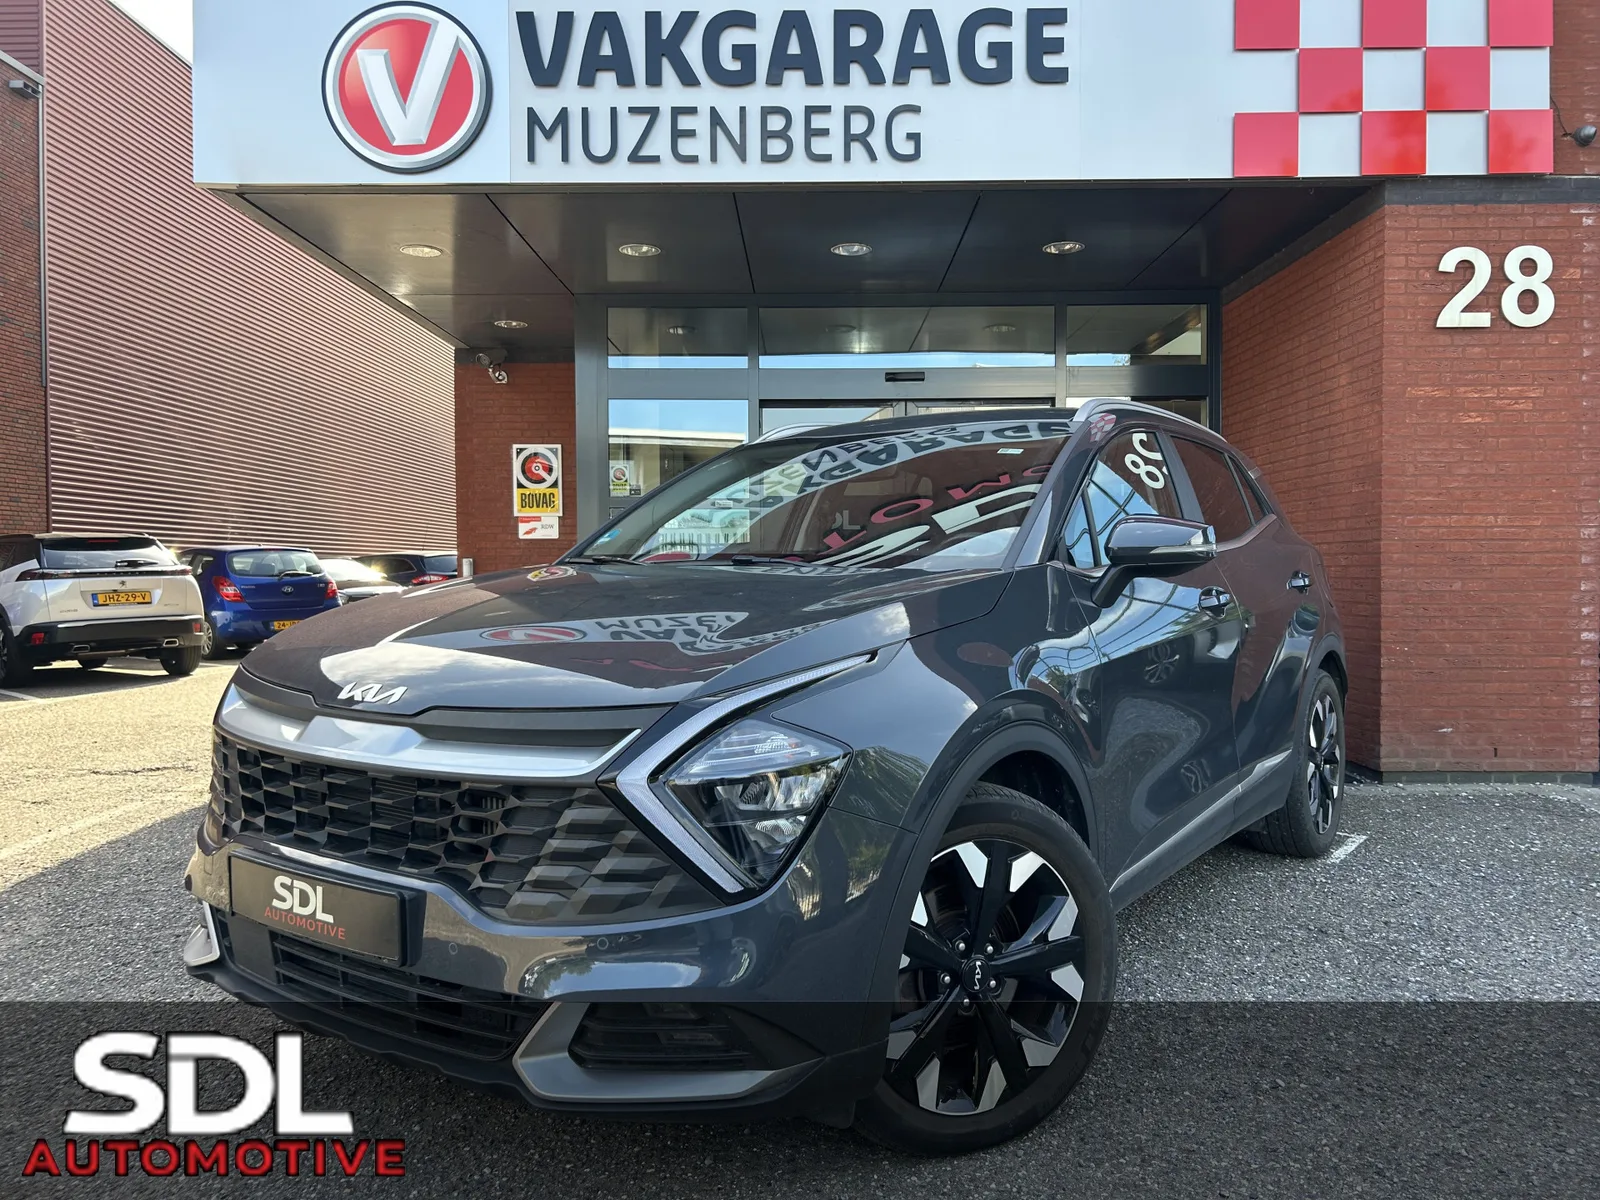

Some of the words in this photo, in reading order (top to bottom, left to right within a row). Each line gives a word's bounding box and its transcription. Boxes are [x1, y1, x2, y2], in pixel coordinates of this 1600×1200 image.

[516, 7, 1069, 87] VAKGARAGE
[526, 103, 923, 164] MUZENBERG
[1436, 245, 1556, 328] 28
[520, 492, 556, 509] BOVAG
[102, 593, 148, 603] JHZ-29-V
[337, 681, 409, 705] KIA
[271, 875, 334, 924] SDL
[263, 906, 346, 940] AUTOMOTIVE
